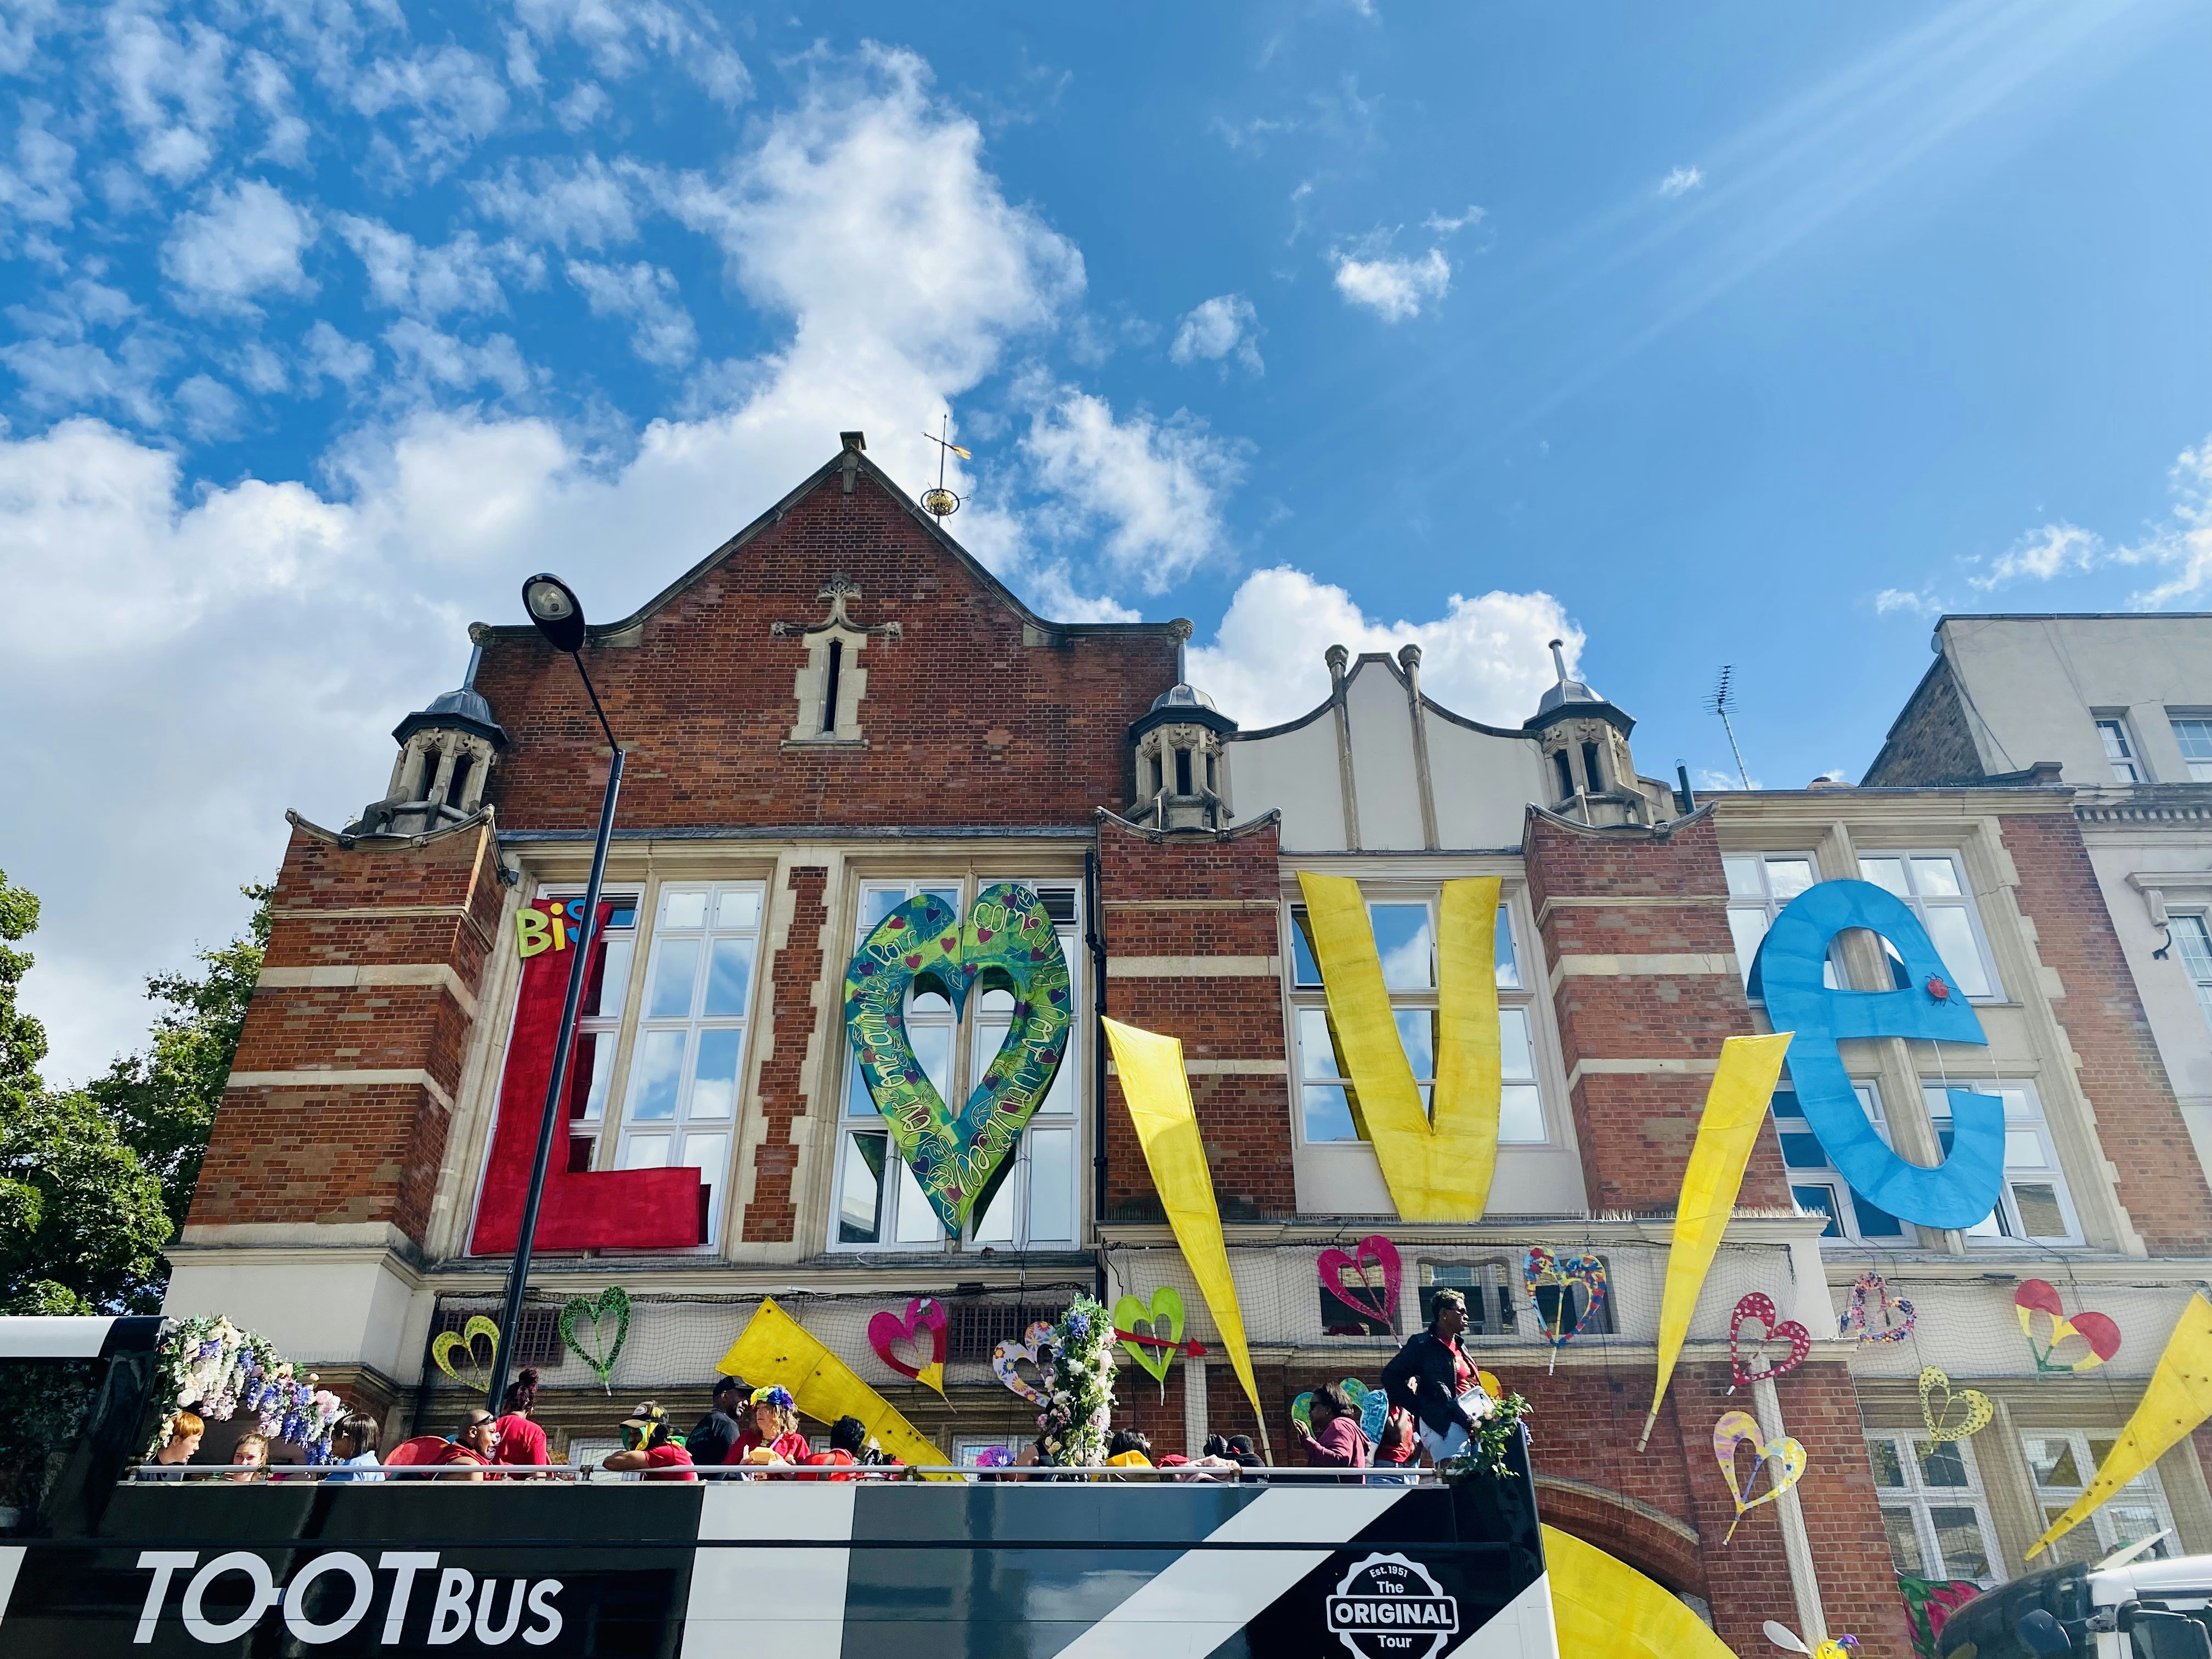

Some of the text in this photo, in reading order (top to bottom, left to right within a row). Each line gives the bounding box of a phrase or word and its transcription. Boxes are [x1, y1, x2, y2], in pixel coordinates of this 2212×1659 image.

[867, 930, 923, 966] love
[1369, 1565, 1408, 1578] Est. 1951
[1376, 1581, 1404, 1593] The
[1335, 1603, 1452, 1624] ORIGINAL
[1378, 1635, 1412, 1648] Tour
